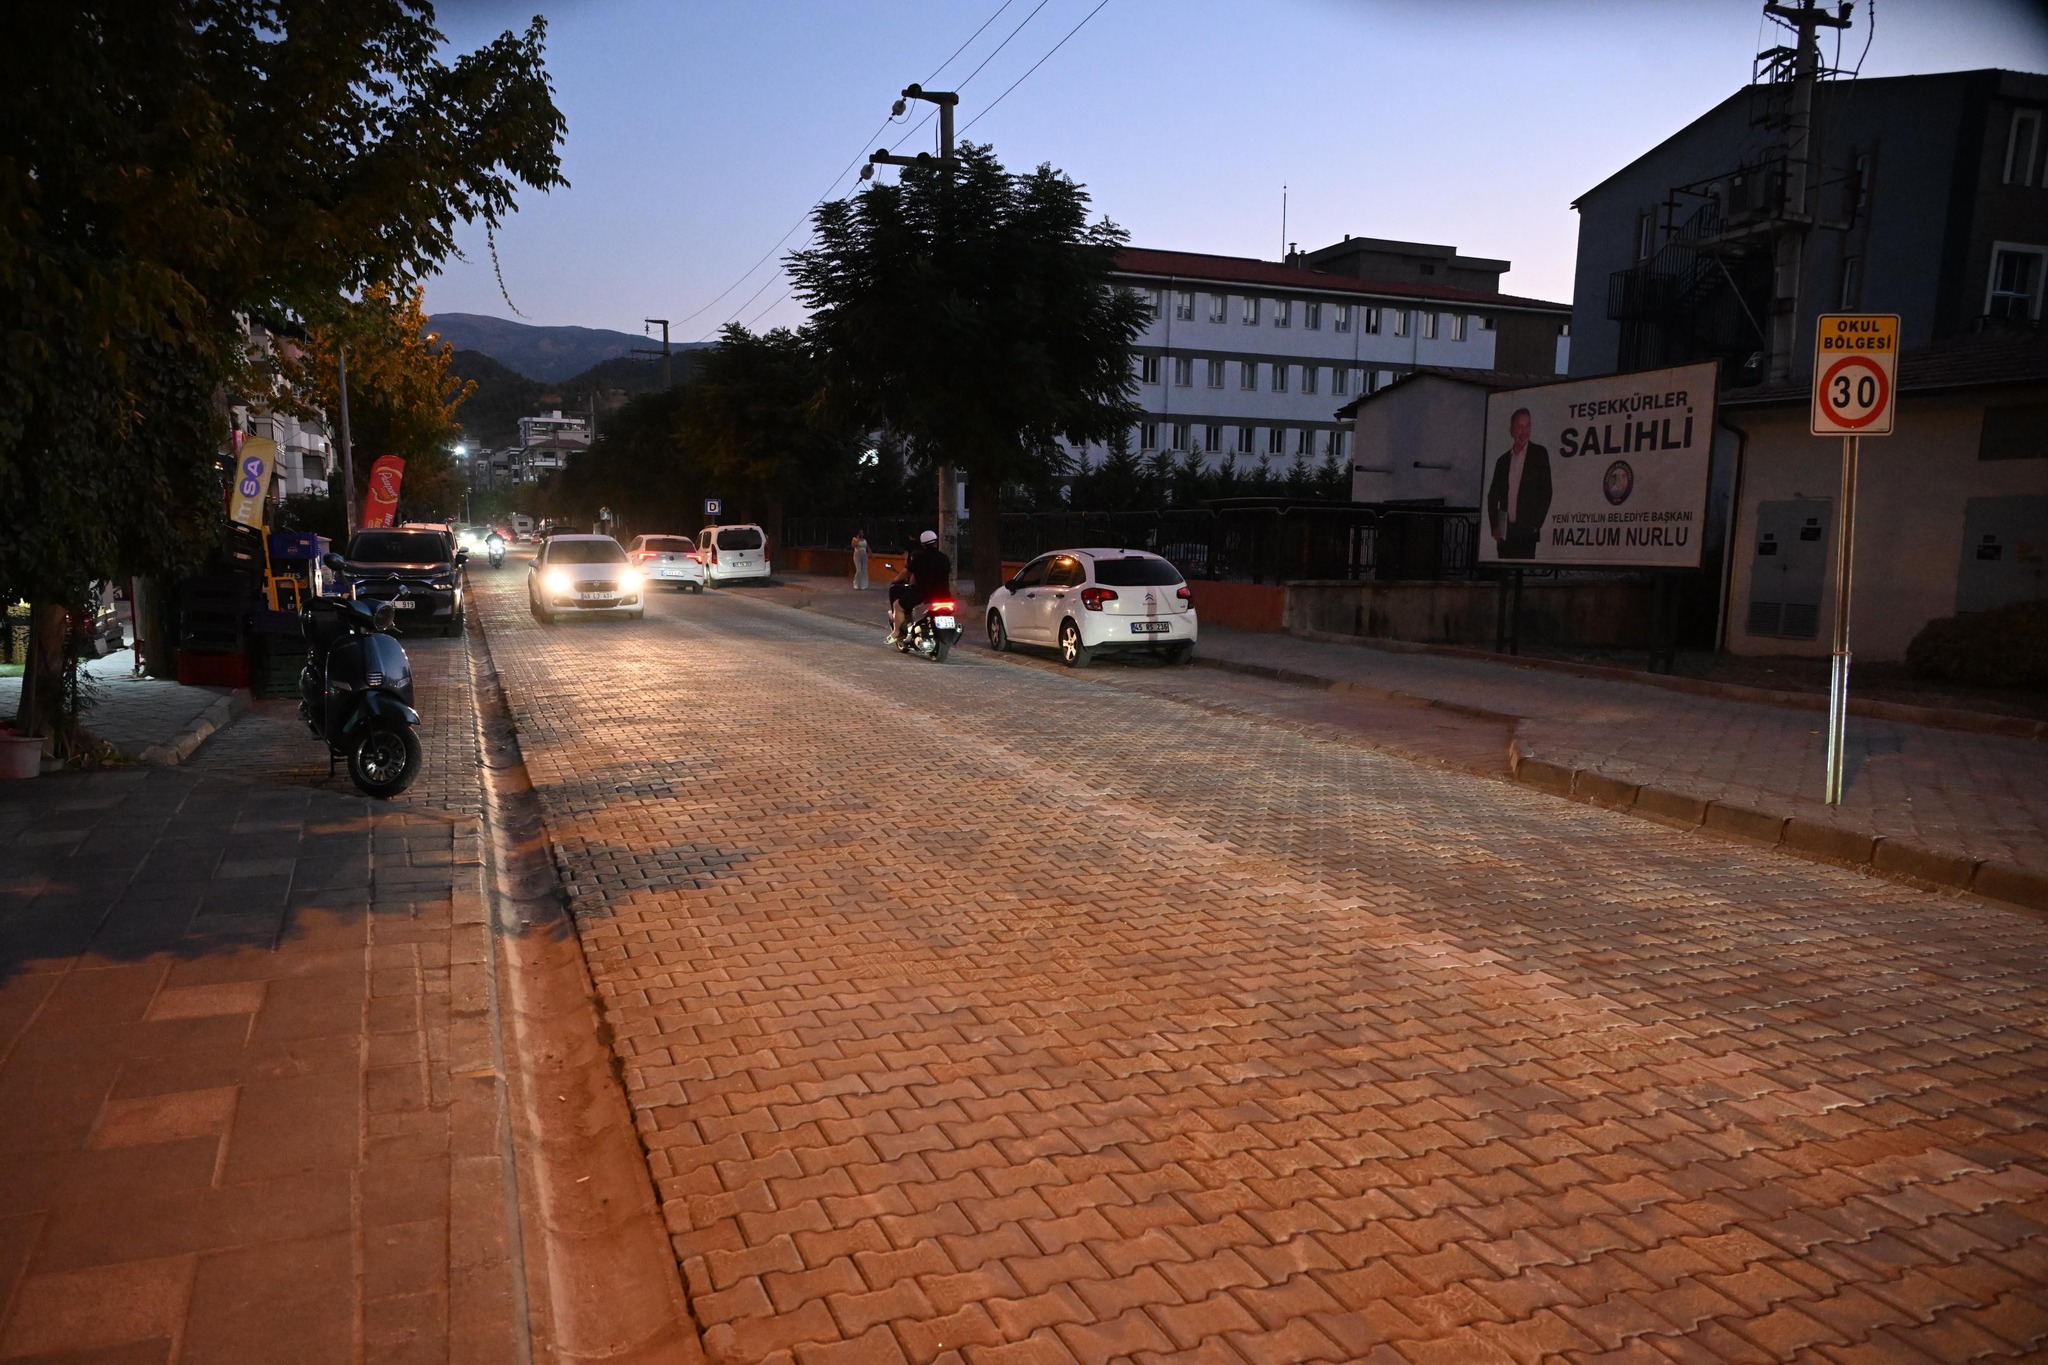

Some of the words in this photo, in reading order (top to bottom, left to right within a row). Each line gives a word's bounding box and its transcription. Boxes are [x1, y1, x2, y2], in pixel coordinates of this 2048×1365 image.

[1837, 320, 1880, 333] OKUL
[1823, 334, 1891, 349] BÖLGESİ
[1832, 375, 1876, 408] 30
[1568, 390, 1689, 420] TEŞEKKÜRLER
[1559, 407, 1694, 458] SALİHLİ
[709, 502, 717, 511] D
[1551, 512, 1570, 523] YENİ
[1571, 511, 1606, 523] YÜZYILIN
[1607, 511, 1649, 523] BELEDİYE
[1651, 510, 1693, 525] BAŞKANI
[1551, 527, 1621, 547] MAZLUM
[1625, 526, 1689, 547] NURLU
[1135, 623, 1143, 631] 45
